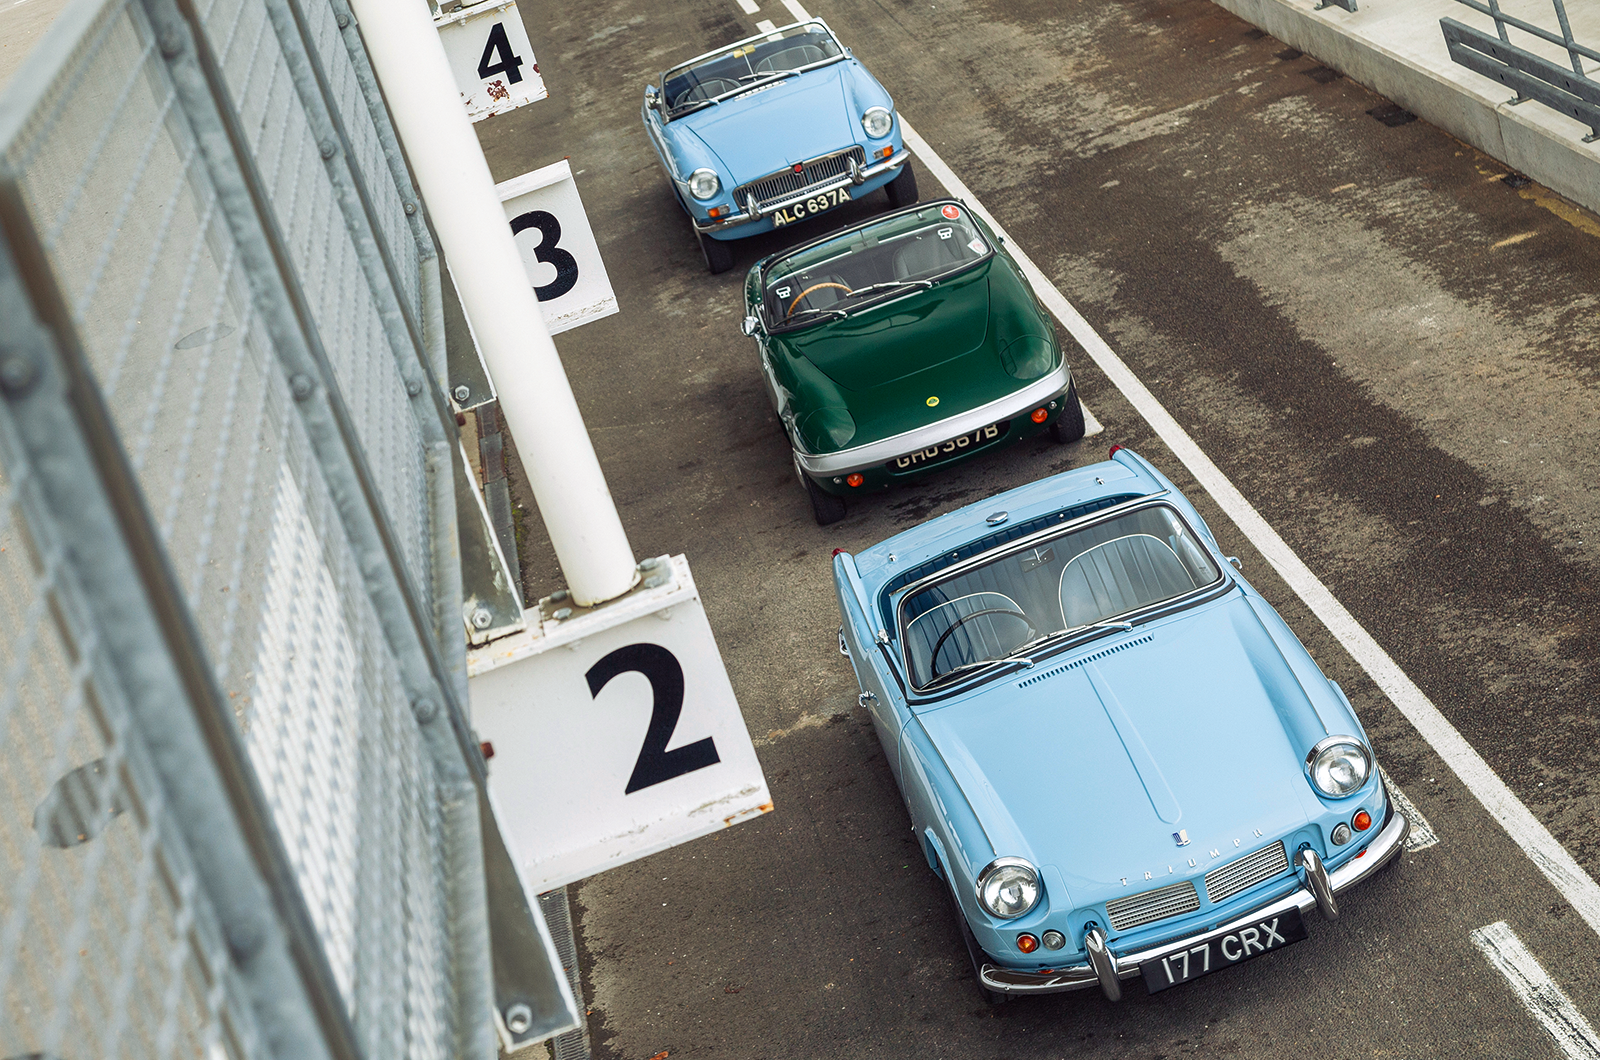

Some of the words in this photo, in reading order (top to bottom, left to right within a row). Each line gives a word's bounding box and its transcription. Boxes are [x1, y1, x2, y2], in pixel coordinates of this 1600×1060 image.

[477, 22, 523, 85] 4
[774, 200, 806, 226] ALC
[806, 187, 850, 213] 637A
[509, 210, 579, 302] 3
[585, 643, 721, 795] 2
[1119, 828, 1263, 886] TRIUMPH
[1161, 943, 1210, 984] 177
[1220, 917, 1286, 961] CRX
